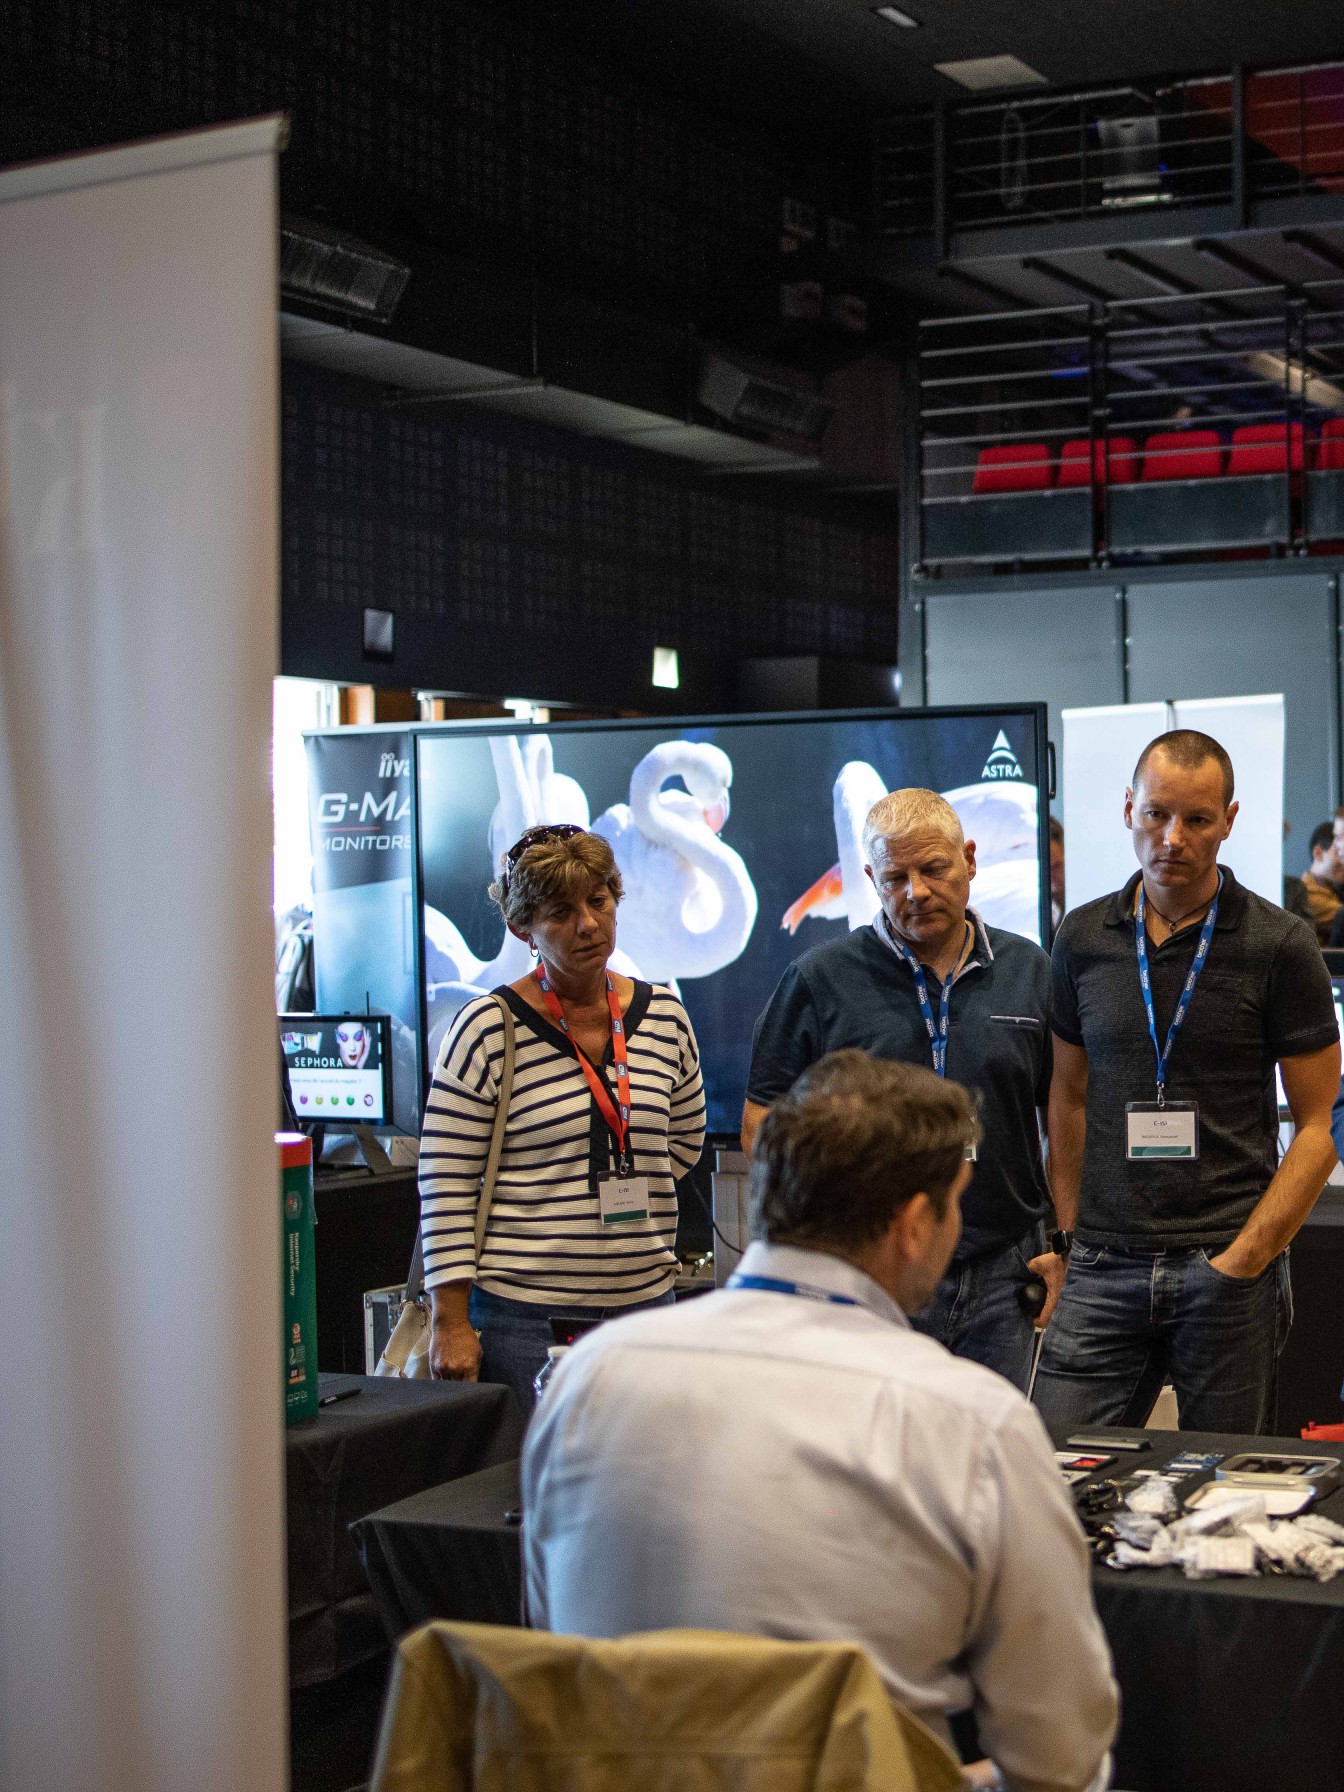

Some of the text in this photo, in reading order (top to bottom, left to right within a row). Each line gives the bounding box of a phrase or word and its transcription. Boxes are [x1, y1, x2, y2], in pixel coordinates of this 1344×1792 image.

[981, 764, 1024, 778] ASTRA
[1196, 937, 1207, 959] brother
[1185, 970, 1196, 991] brother
[917, 985, 926, 1005] brother
[1173, 1005, 1184, 1026] brother
[294, 1056, 343, 1068] SEPHORA
